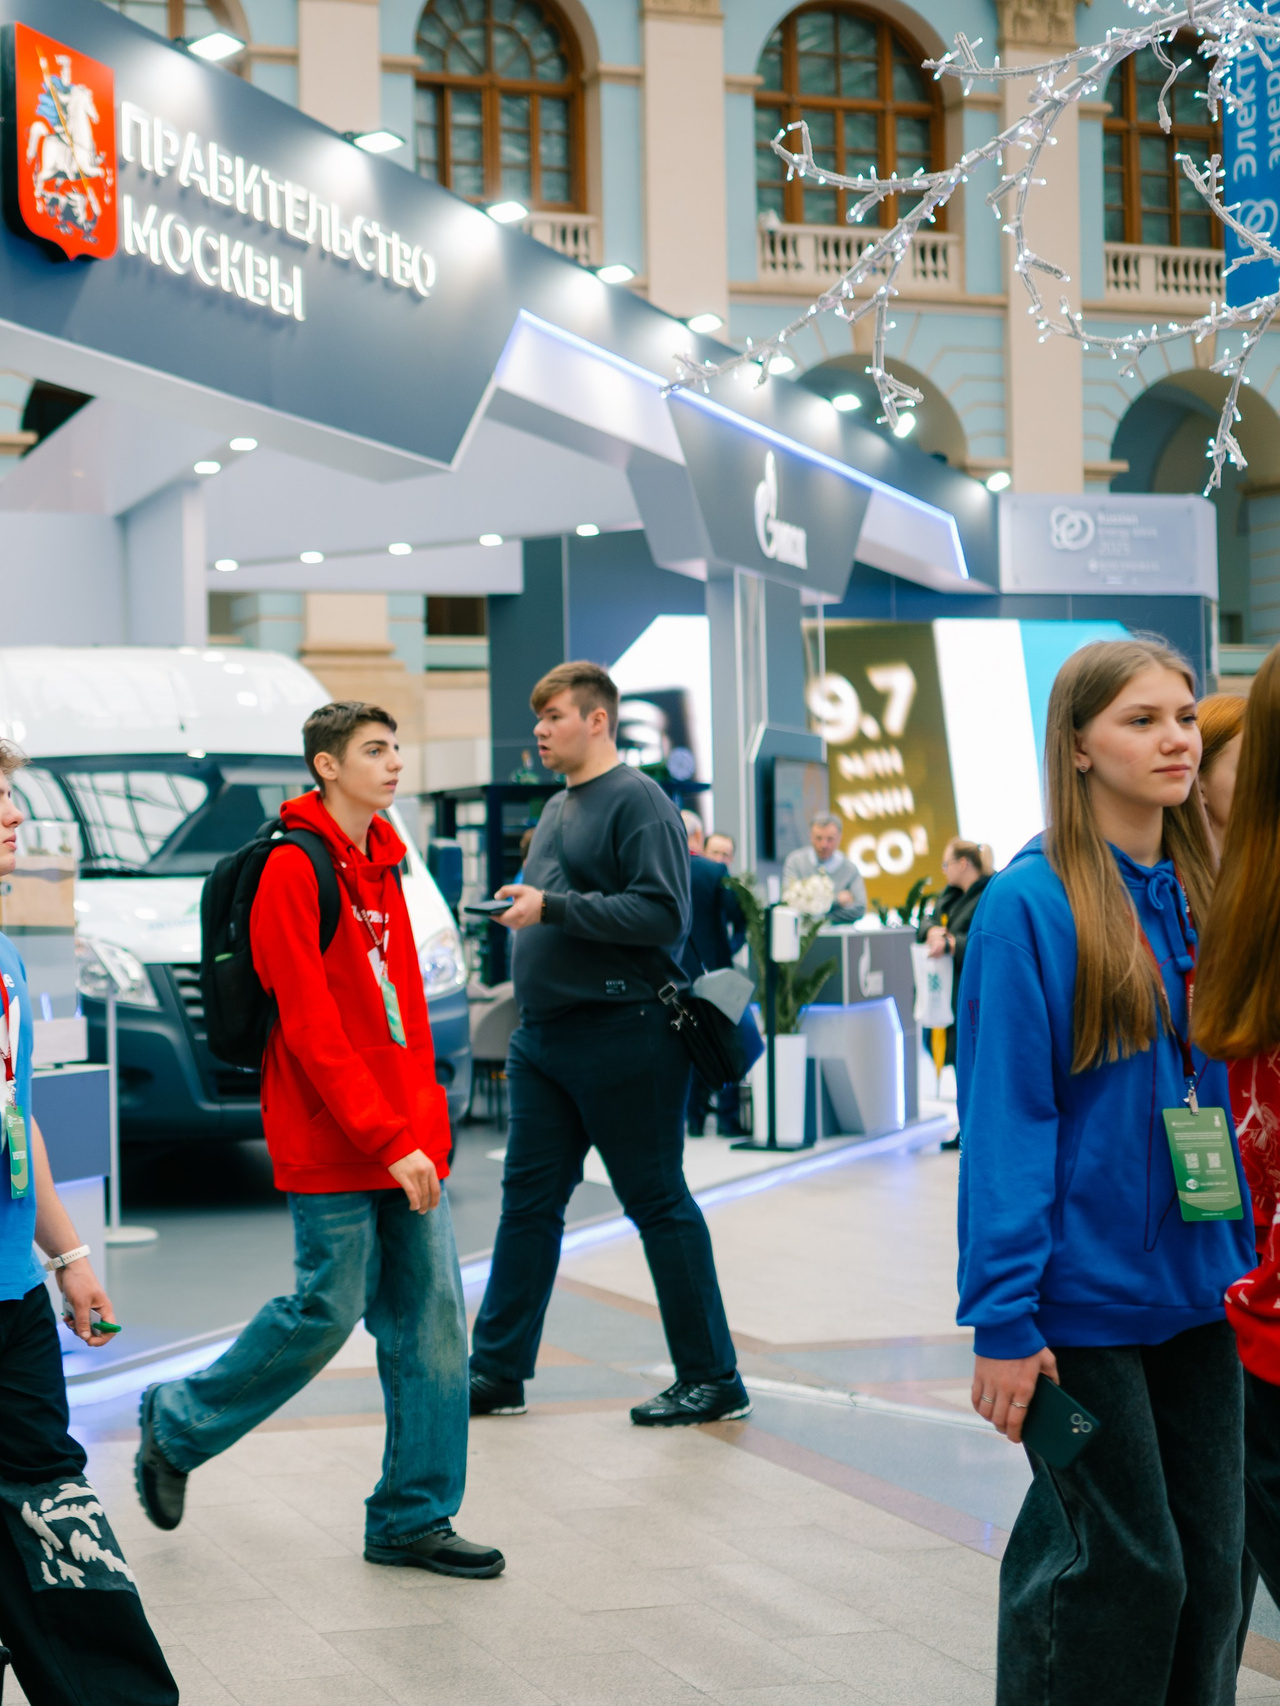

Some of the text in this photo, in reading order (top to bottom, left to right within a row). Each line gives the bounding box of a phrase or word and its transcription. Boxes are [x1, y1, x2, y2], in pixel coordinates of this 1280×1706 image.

[120, 99, 437, 298] ПРАВИТЕЛЬСТВО
[122, 195, 307, 321] МОСКВЫ
[805, 661, 917, 744] 9.7
